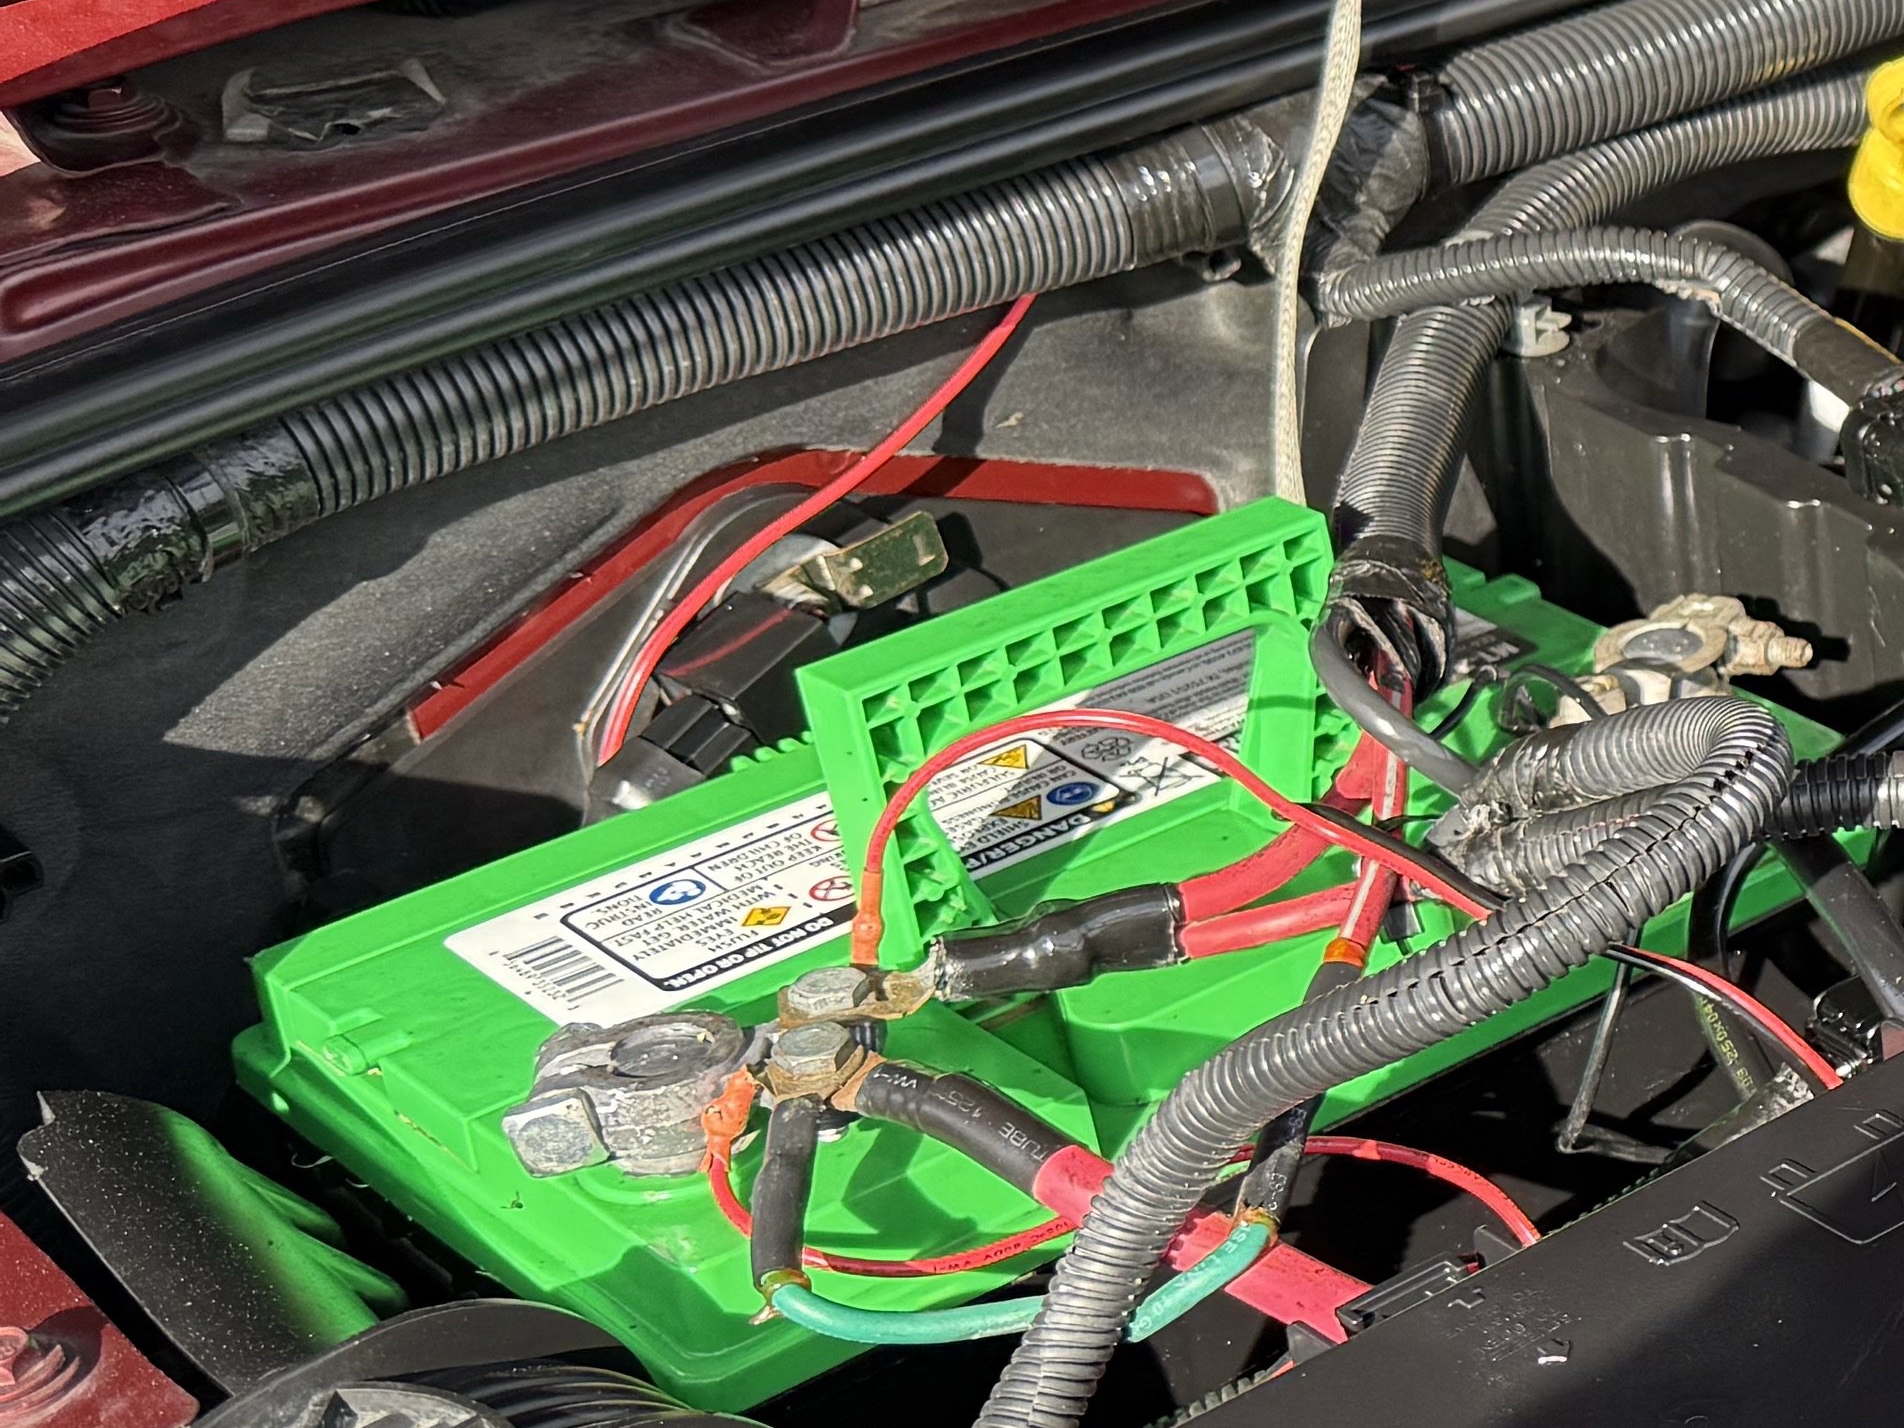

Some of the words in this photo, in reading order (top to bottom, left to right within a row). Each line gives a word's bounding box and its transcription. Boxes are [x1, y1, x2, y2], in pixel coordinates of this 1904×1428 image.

[780, 835, 812, 855] THE
[781, 828, 803, 845] OF
[707, 836, 781, 875] CHILDREN
[733, 846, 784, 874] REACH
[785, 840, 822, 863] KEEP
[731, 868, 754, 884] OF
[751, 856, 785, 877] OUT
[692, 880, 763, 917] MEDICAL
[731, 887, 775, 913] WITH
[619, 904, 663, 930] READ
[651, 909, 693, 934] HELP
[802, 913, 834, 935] DO
[630, 911, 738, 964] IMMEDIATELY
[640, 928, 672, 948] GET
[693, 925, 734, 950] EYES
[705, 926, 759, 956] FLUSH
[769, 924, 808, 948] NOT
[742, 938, 773, 960] TIP
[710, 951, 740, 973] OR
[661, 961, 714, 992] OPEN.
[993, 1119, 1054, 1164] TUBE
